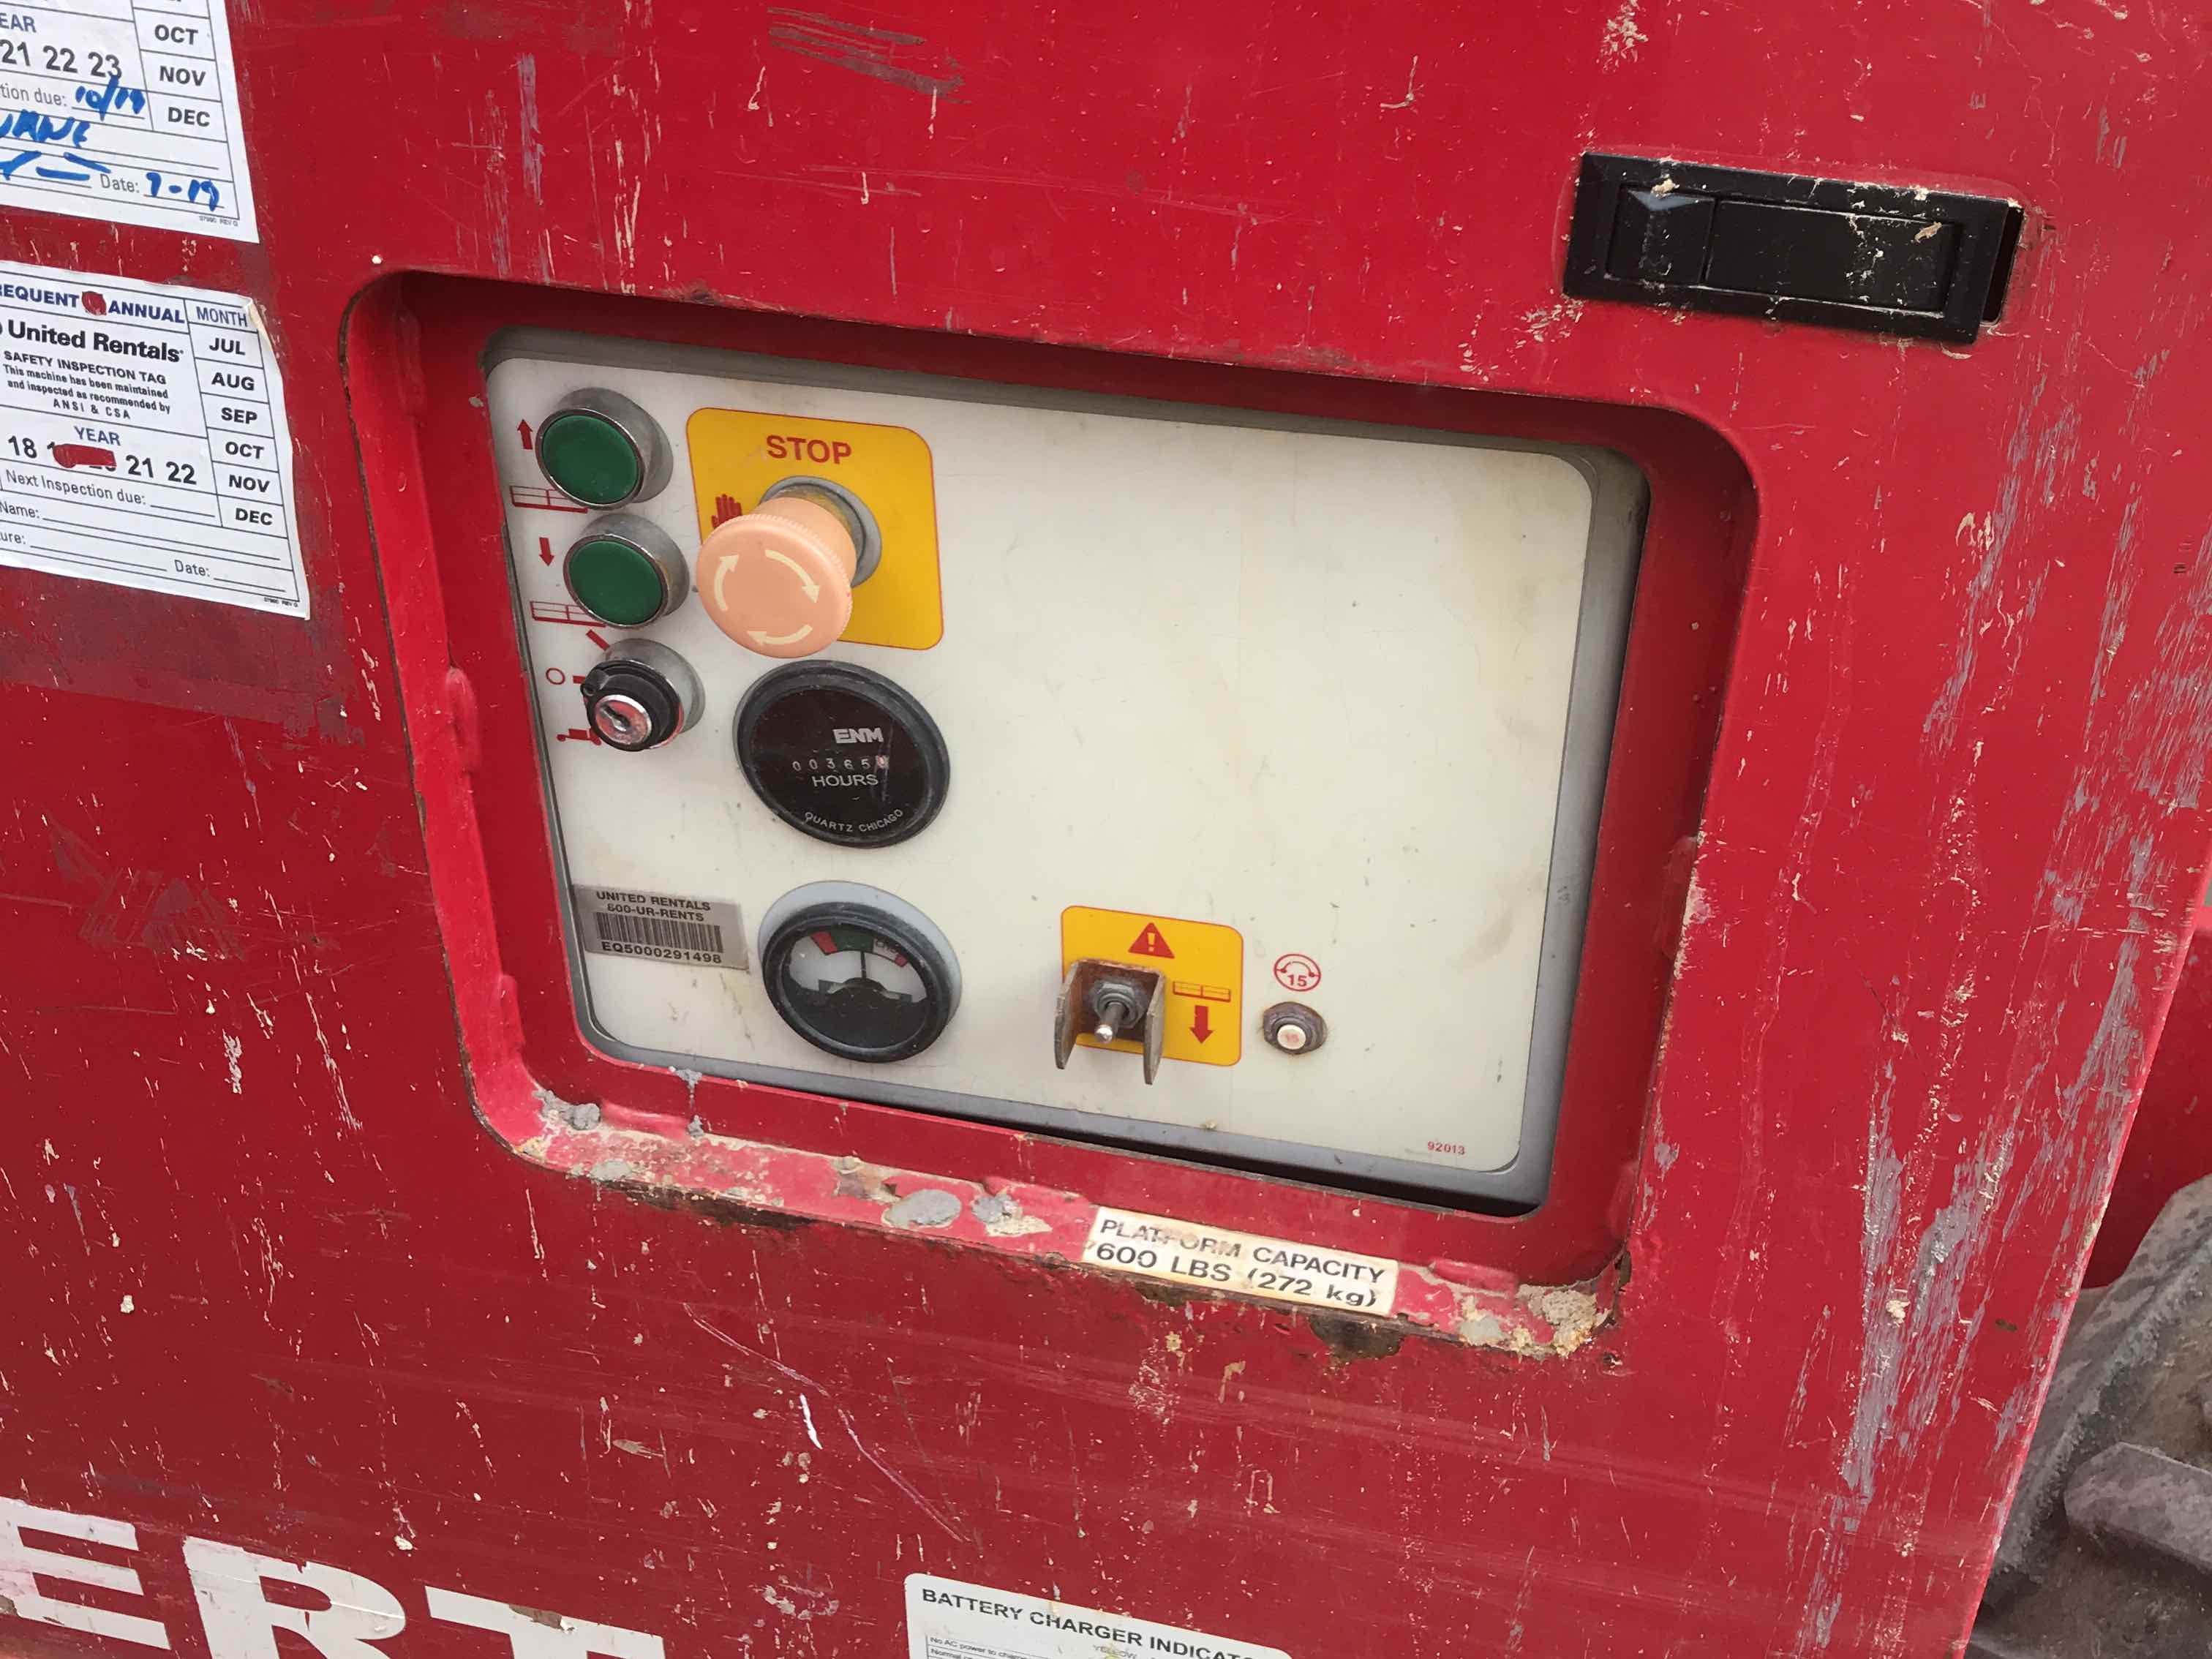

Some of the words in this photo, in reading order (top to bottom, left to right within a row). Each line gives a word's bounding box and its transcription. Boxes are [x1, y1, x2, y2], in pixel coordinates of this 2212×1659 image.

[154, 25, 198, 45] OCT
[1, 39, 30, 67] 21
[42, 45, 78, 73] 22
[87, 51, 122, 79] 23
[159, 66, 207, 87] NOV
[34, 87, 67, 107] due:
[168, 107, 211, 127] DEC
[100, 173, 140, 193] Date:
[0, 284, 80, 307] EQUENT
[108, 300, 185, 323] ANNUAL
[196, 306, 248, 328] MONTH
[8, 319, 86, 349] United
[94, 331, 182, 363] Rentals
[209, 337, 246, 356] JUL
[4, 350, 53, 367] SAFETY
[57, 358, 136, 380] INSPECTION
[139, 371, 167, 385] TAG
[4, 364, 24, 377] This
[26, 369, 67, 383] machine
[69, 375, 86, 385] has
[89, 378, 113, 390] been
[115, 383, 169, 399] maintained
[211, 372, 255, 391] AUG
[7, 379, 25, 389] and
[28, 380, 74, 398] inspected
[76, 391, 87, 400] as
[90, 393, 157, 411] recommended
[159, 403, 170, 415] by
[53, 398, 85, 413] ANSI
[91, 404, 99, 414] &
[105, 406, 131, 420] CSA
[221, 407, 257, 425] SEP
[74, 426, 121, 446] YEAR
[225, 441, 265, 460] OCT
[766, 434, 852, 464] STOP
[8, 435, 37, 459] 18
[126, 454, 154, 479] 21
[166, 462, 197, 485] 22
[6, 469, 38, 488] Next
[41, 475, 113, 500] Inspection
[117, 488, 146, 505] due:
[228, 474, 270, 494] NOV
[235, 508, 274, 526] DEC
[174, 559, 211, 578] Date:
[832, 727, 884, 744] ENM
[811, 774, 878, 787] HOURS
[804, 811, 853, 832] QUARTZ
[858, 808, 903, 832] CHICAGO
[596, 891, 645, 903] UNITED
[650, 896, 711, 911] RENTALS
[601, 941, 722, 964] EQ5000291498
[1287, 974, 1307, 987] 15
[1428, 1141, 1466, 1155] 92013
[1096, 1243, 1158, 1268] 600
[1170, 1255, 1233, 1282] LBS
[1246, 1268, 1313, 1296] (272
[1326, 1284, 1378, 1307] kg)
[1253, 1246, 1385, 1284] CAPACITY
[922, 1588, 1023, 1621] BATTERY
[1030, 1611, 1142, 1647] CHARGER
[944, 1639, 958, 1647] AC
[960, 1644, 986, 1653] power
